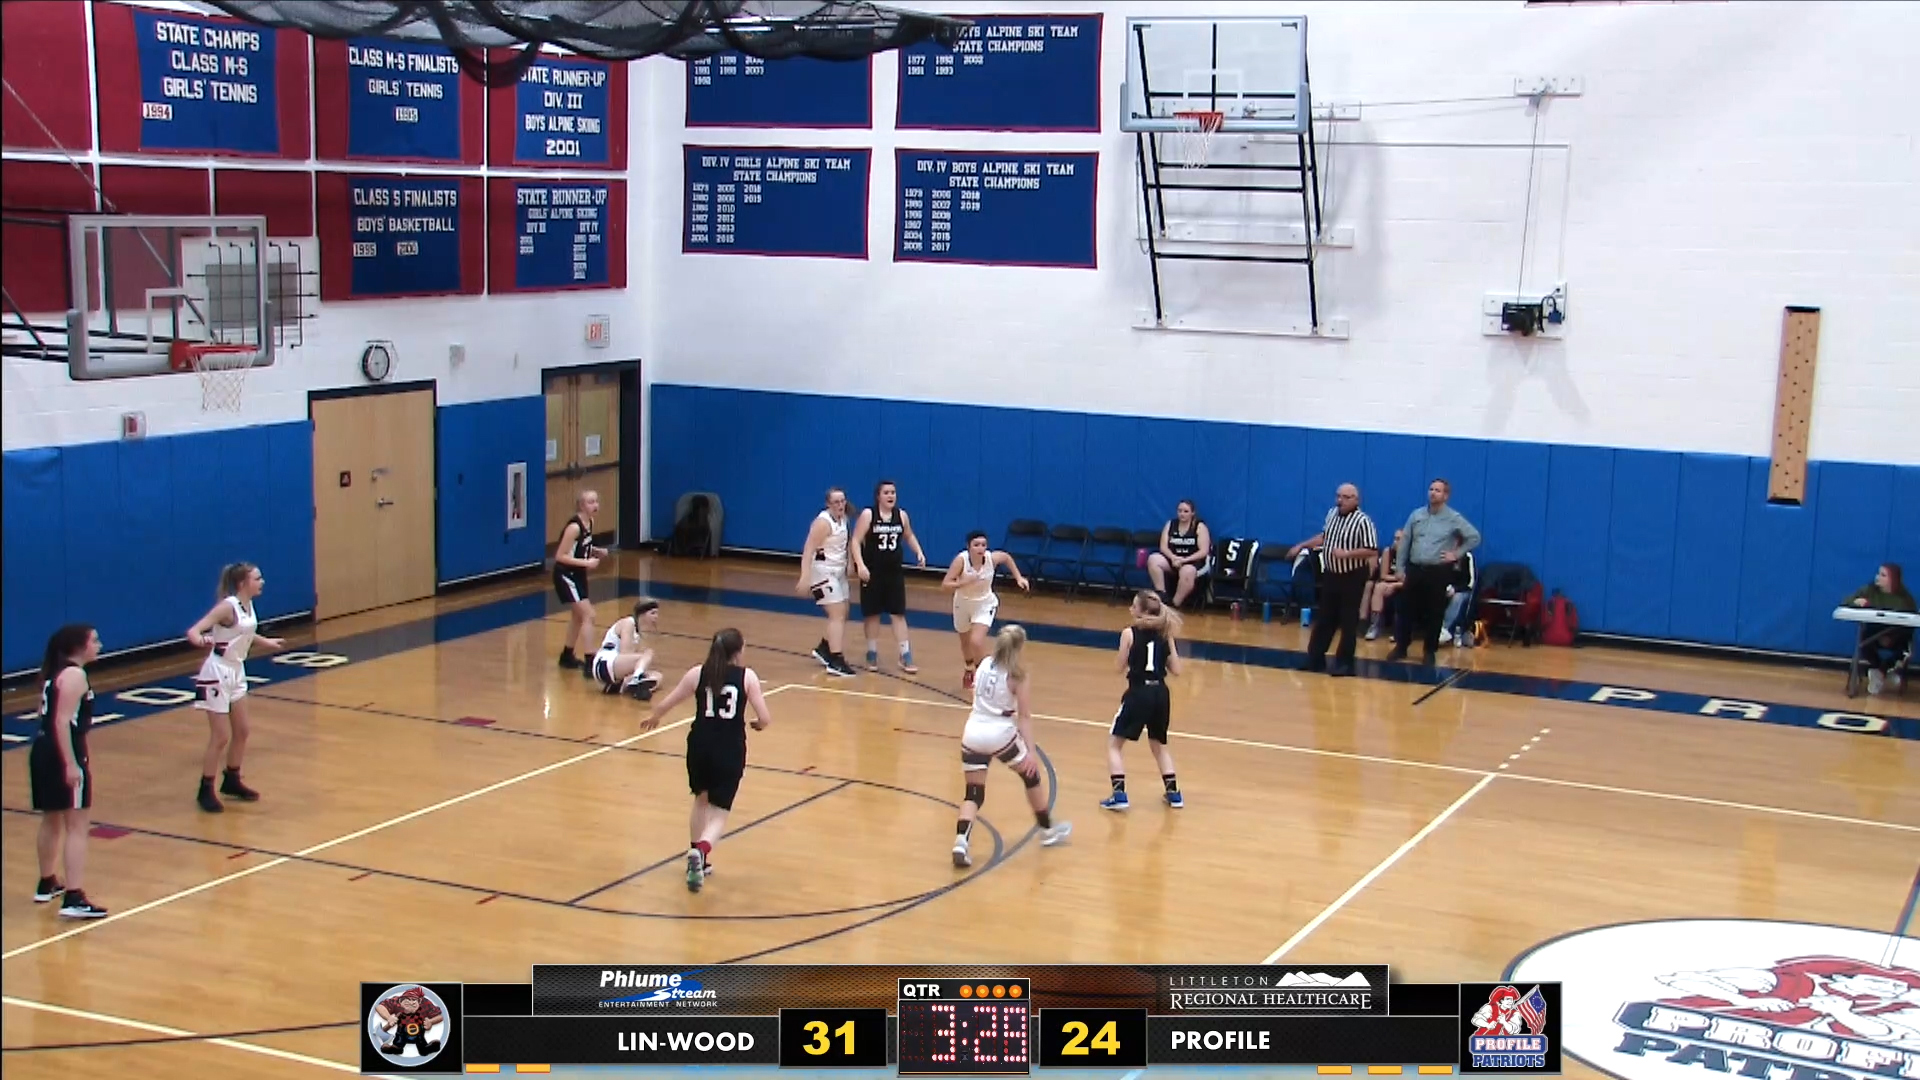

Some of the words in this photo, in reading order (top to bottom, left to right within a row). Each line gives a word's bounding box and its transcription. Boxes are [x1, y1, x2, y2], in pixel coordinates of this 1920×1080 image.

[157, 21, 200, 45] STATE
[204, 28, 260, 51] CHAMPS
[986, 26, 1022, 37] ALPINE
[1028, 26, 1045, 37] SKI
[1051, 26, 1079, 38] TEAM
[988, 40, 1043, 53] CHAMPIONS
[171, 50, 219, 73] CLASS
[225, 56, 248, 76] M-S
[348, 46, 383, 67] CLASS
[408, 54, 459, 74] FINALISTS
[552, 69, 606, 87] RUNNER-UP
[163, 77, 206, 99] GIRLS'
[211, 81, 258, 103] TENNIS
[368, 78, 402, 96] GIRLS'
[406, 82, 443, 99] TENNIS
[544, 91, 563, 108] DIV.
[567, 93, 582, 109] III
[525, 114, 545, 132] BOYS
[548, 116, 574, 132] ALPINE
[546, 140, 580, 156] 2001
[735, 157, 761, 168] GIRLS
[766, 158, 800, 170] ALPINE
[804, 158, 820, 170] SKI
[825, 158, 851, 171] TEAM
[952, 162, 977, 174] BOYS
[982, 162, 1018, 174] ALPINE
[1023, 163, 1041, 175] SKI
[1047, 164, 1074, 175] TEAM
[733, 171, 761, 182] STATE
[766, 172, 817, 183] CHAMPIONS
[949, 176, 979, 188] STATE
[984, 178, 1040, 189] CHAMPIONS
[354, 188, 389, 206] CLASS
[393, 190, 400, 206] S
[403, 190, 456, 207] FINALISTS
[517, 188, 547, 205] STATE
[552, 189, 607, 206] RUNNER-UP
[389, 217, 455, 233] BASKETBALL
[878, 533, 899, 551] 33
[1226, 540, 1240, 562] 5
[1145, 640, 1155, 671] 1
[705, 685, 739, 719] 13
